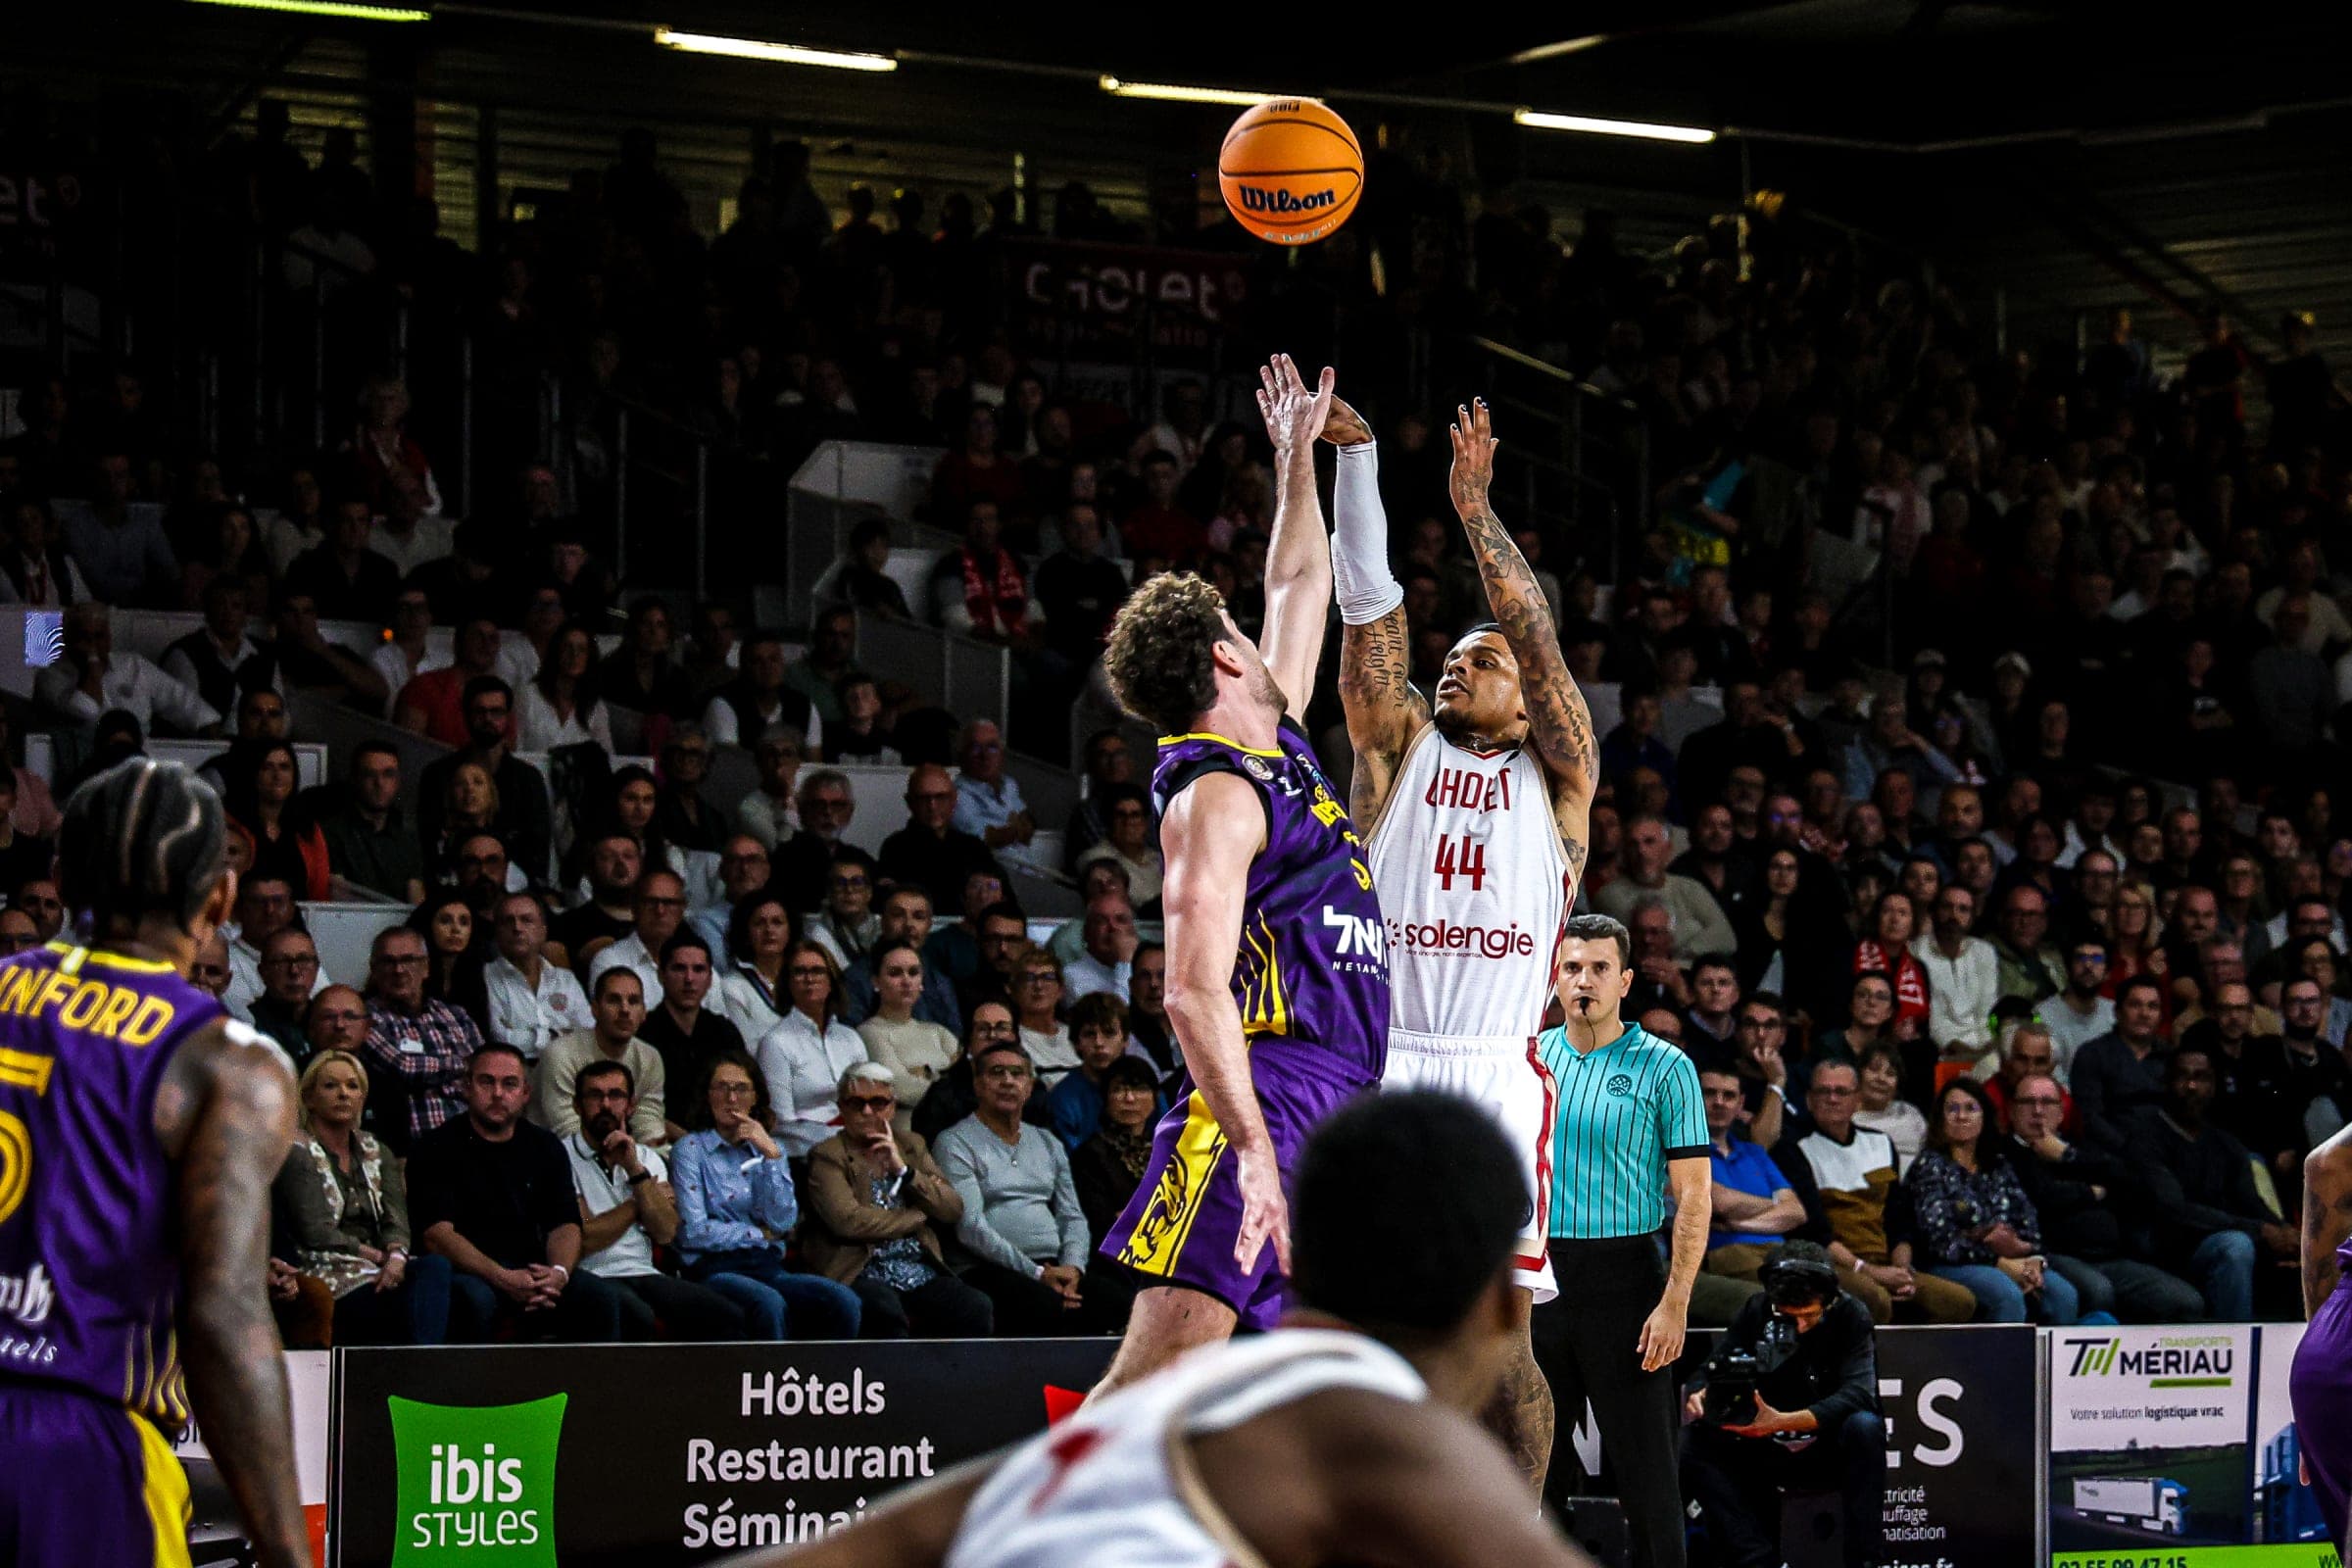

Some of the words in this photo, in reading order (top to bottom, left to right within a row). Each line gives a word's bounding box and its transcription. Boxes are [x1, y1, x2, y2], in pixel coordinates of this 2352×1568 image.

[1239, 182, 1336, 214] Wilson
[1434, 833, 1487, 892] 44
[1404, 918, 1534, 959] solengie
[2120, 1342, 2232, 1376] MÉRIAU
[2160, 1336, 2233, 1348] TRANSPORTS
[740, 1365, 886, 1417] Hôtels
[2070, 1407, 2098, 1420] Votre
[2101, 1405, 2143, 1420] solution
[2144, 1405, 2198, 1421] logistique
[2200, 1405, 2224, 1417] vrac
[430, 1443, 523, 1504] ibis
[687, 1435, 935, 1483] Restaurant
[683, 1495, 875, 1549] Séminai
